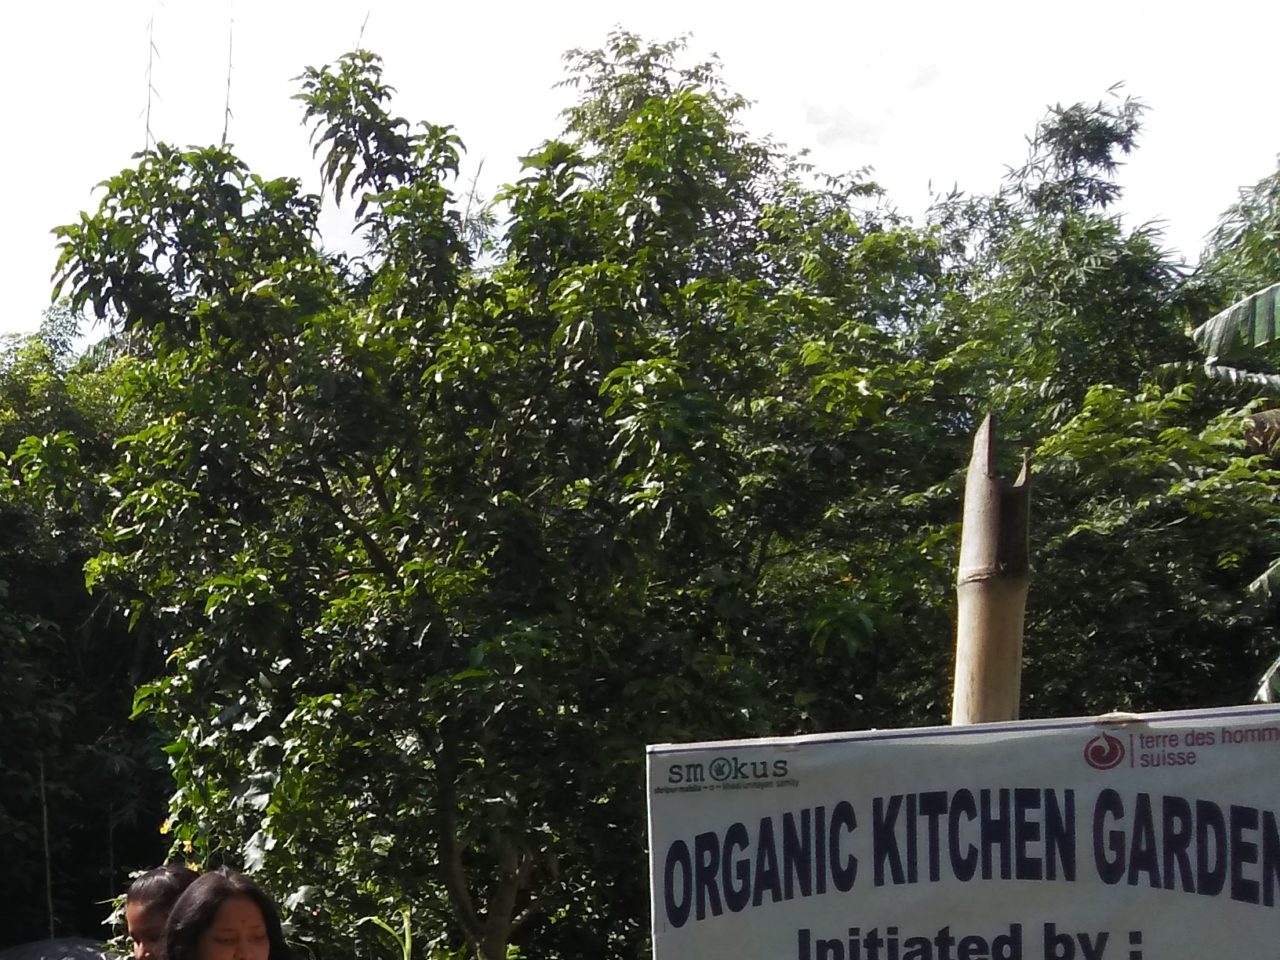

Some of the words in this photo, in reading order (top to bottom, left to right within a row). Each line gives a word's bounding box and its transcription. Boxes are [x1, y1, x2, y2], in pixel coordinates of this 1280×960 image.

[1140, 733, 1179, 749] terre
[1185, 730, 1215, 746] des
[1140, 751, 1197, 768] suisse
[664, 801, 858, 928] ORGANIC
[873, 788, 1076, 887] KITCHEN
